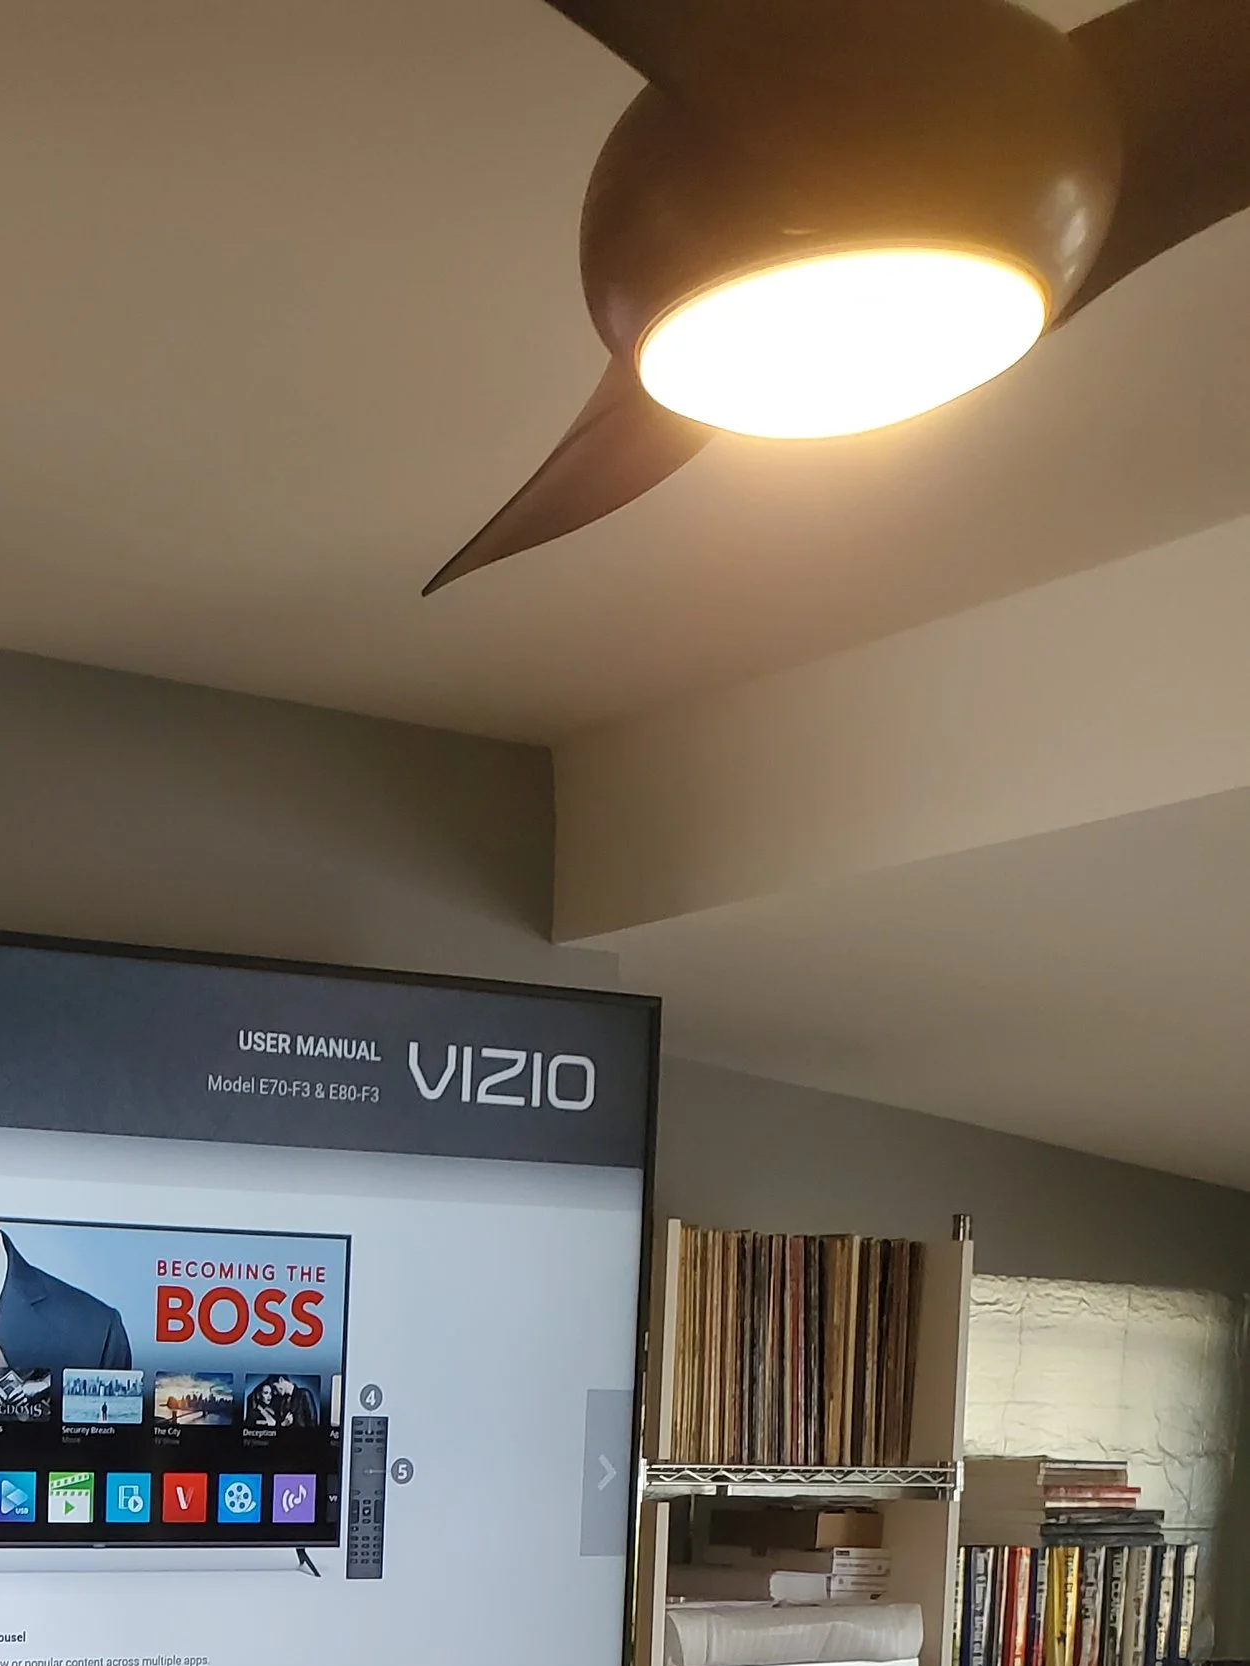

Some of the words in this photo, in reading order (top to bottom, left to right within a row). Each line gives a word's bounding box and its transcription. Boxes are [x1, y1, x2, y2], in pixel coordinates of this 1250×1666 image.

[238, 1030, 291, 1055] USER
[296, 1035, 382, 1062] MANUAL
[408, 1041, 596, 1112] VIZIO
[207, 1074, 255, 1094] Model
[259, 1078, 310, 1098] E70-F3
[315, 1083, 325, 1099] &
[329, 1083, 380, 1104] E80-F3
[157, 1259, 276, 1281] BECOMING
[286, 1265, 326, 1283] THE
[156, 1285, 325, 1348] BOSS
[365, 1389, 376, 1406] 4
[91, 1426, 115, 1435] Breach
[154, 1427, 167, 1436] The
[168, 1427, 181, 1437] City
[243, 1428, 276, 1439] Deception
[397, 1463, 408, 1480] 5
[15, 1507, 29, 1515] USB
[105, 1658, 140, 1666] across
[183, 1656, 211, 1666] apps.
